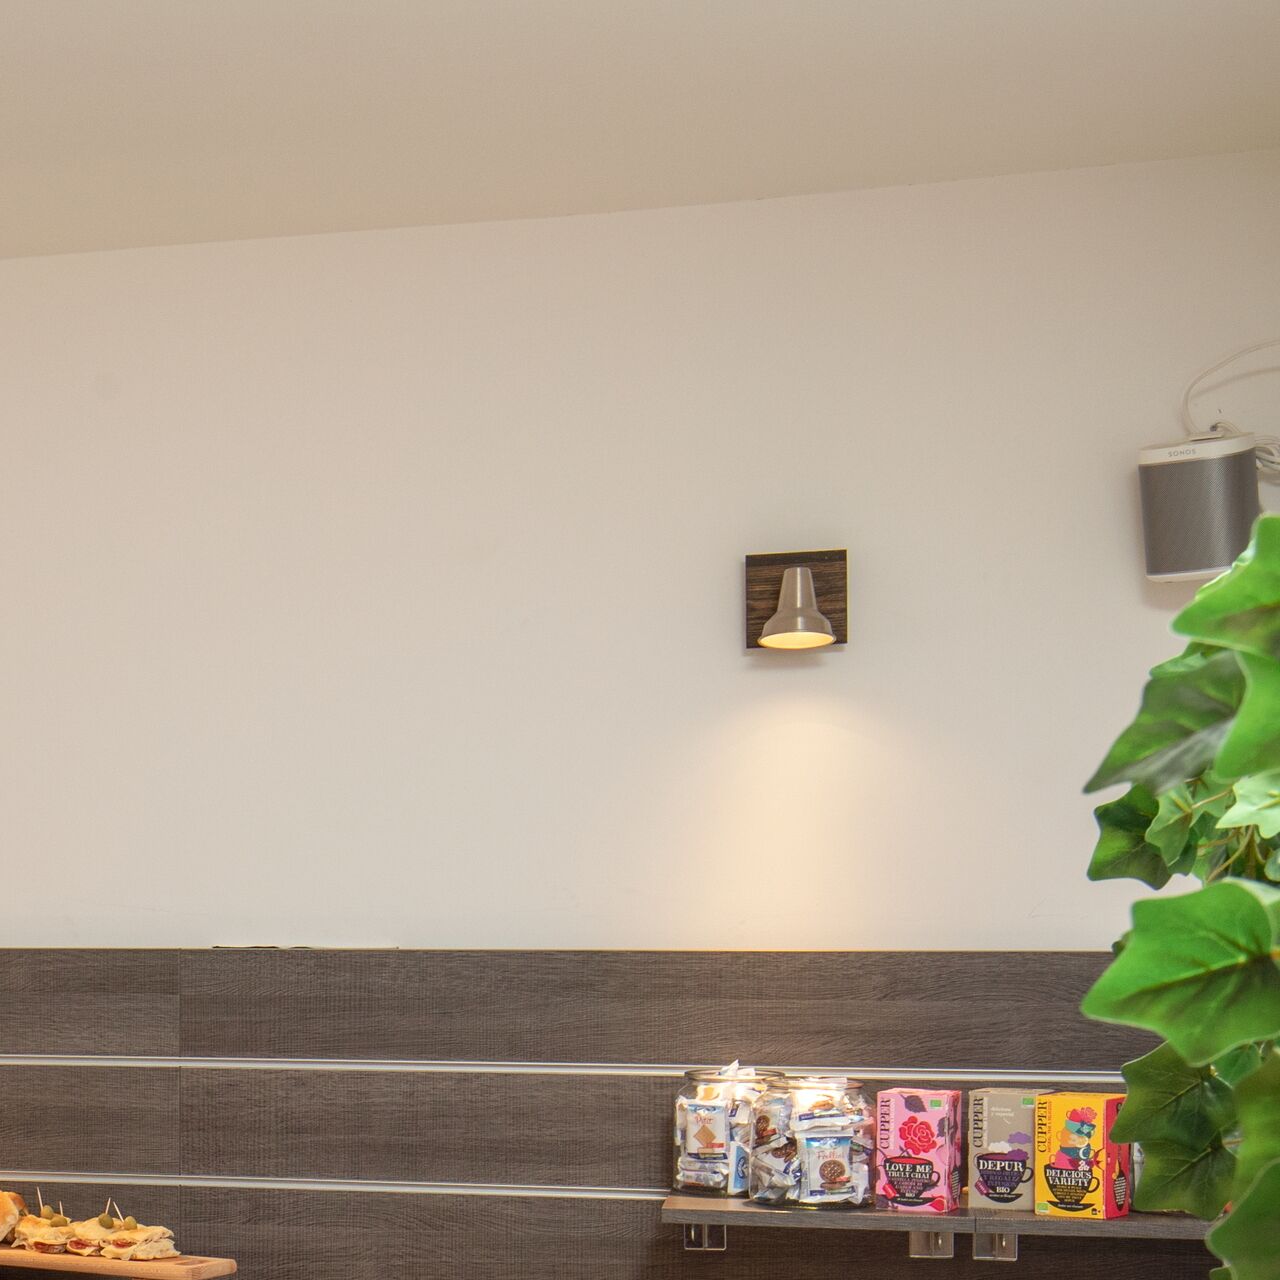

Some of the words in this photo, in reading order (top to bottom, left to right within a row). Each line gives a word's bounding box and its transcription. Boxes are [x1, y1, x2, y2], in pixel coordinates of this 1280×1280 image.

[1168, 449, 1196, 457] SONOS
[880, 1099, 891, 1150] CUPPER
[973, 1097, 984, 1148] CUPPER
[1037, 1100, 1047, 1153] CUPPER
[886, 1163, 912, 1172] LOVE
[916, 1164, 932, 1173] ME
[979, 1160, 1024, 1172] DEPUR
[1046, 1168, 1091, 1179] DELICIOUS
[1048, 1177, 1089, 1187] VARIETY
